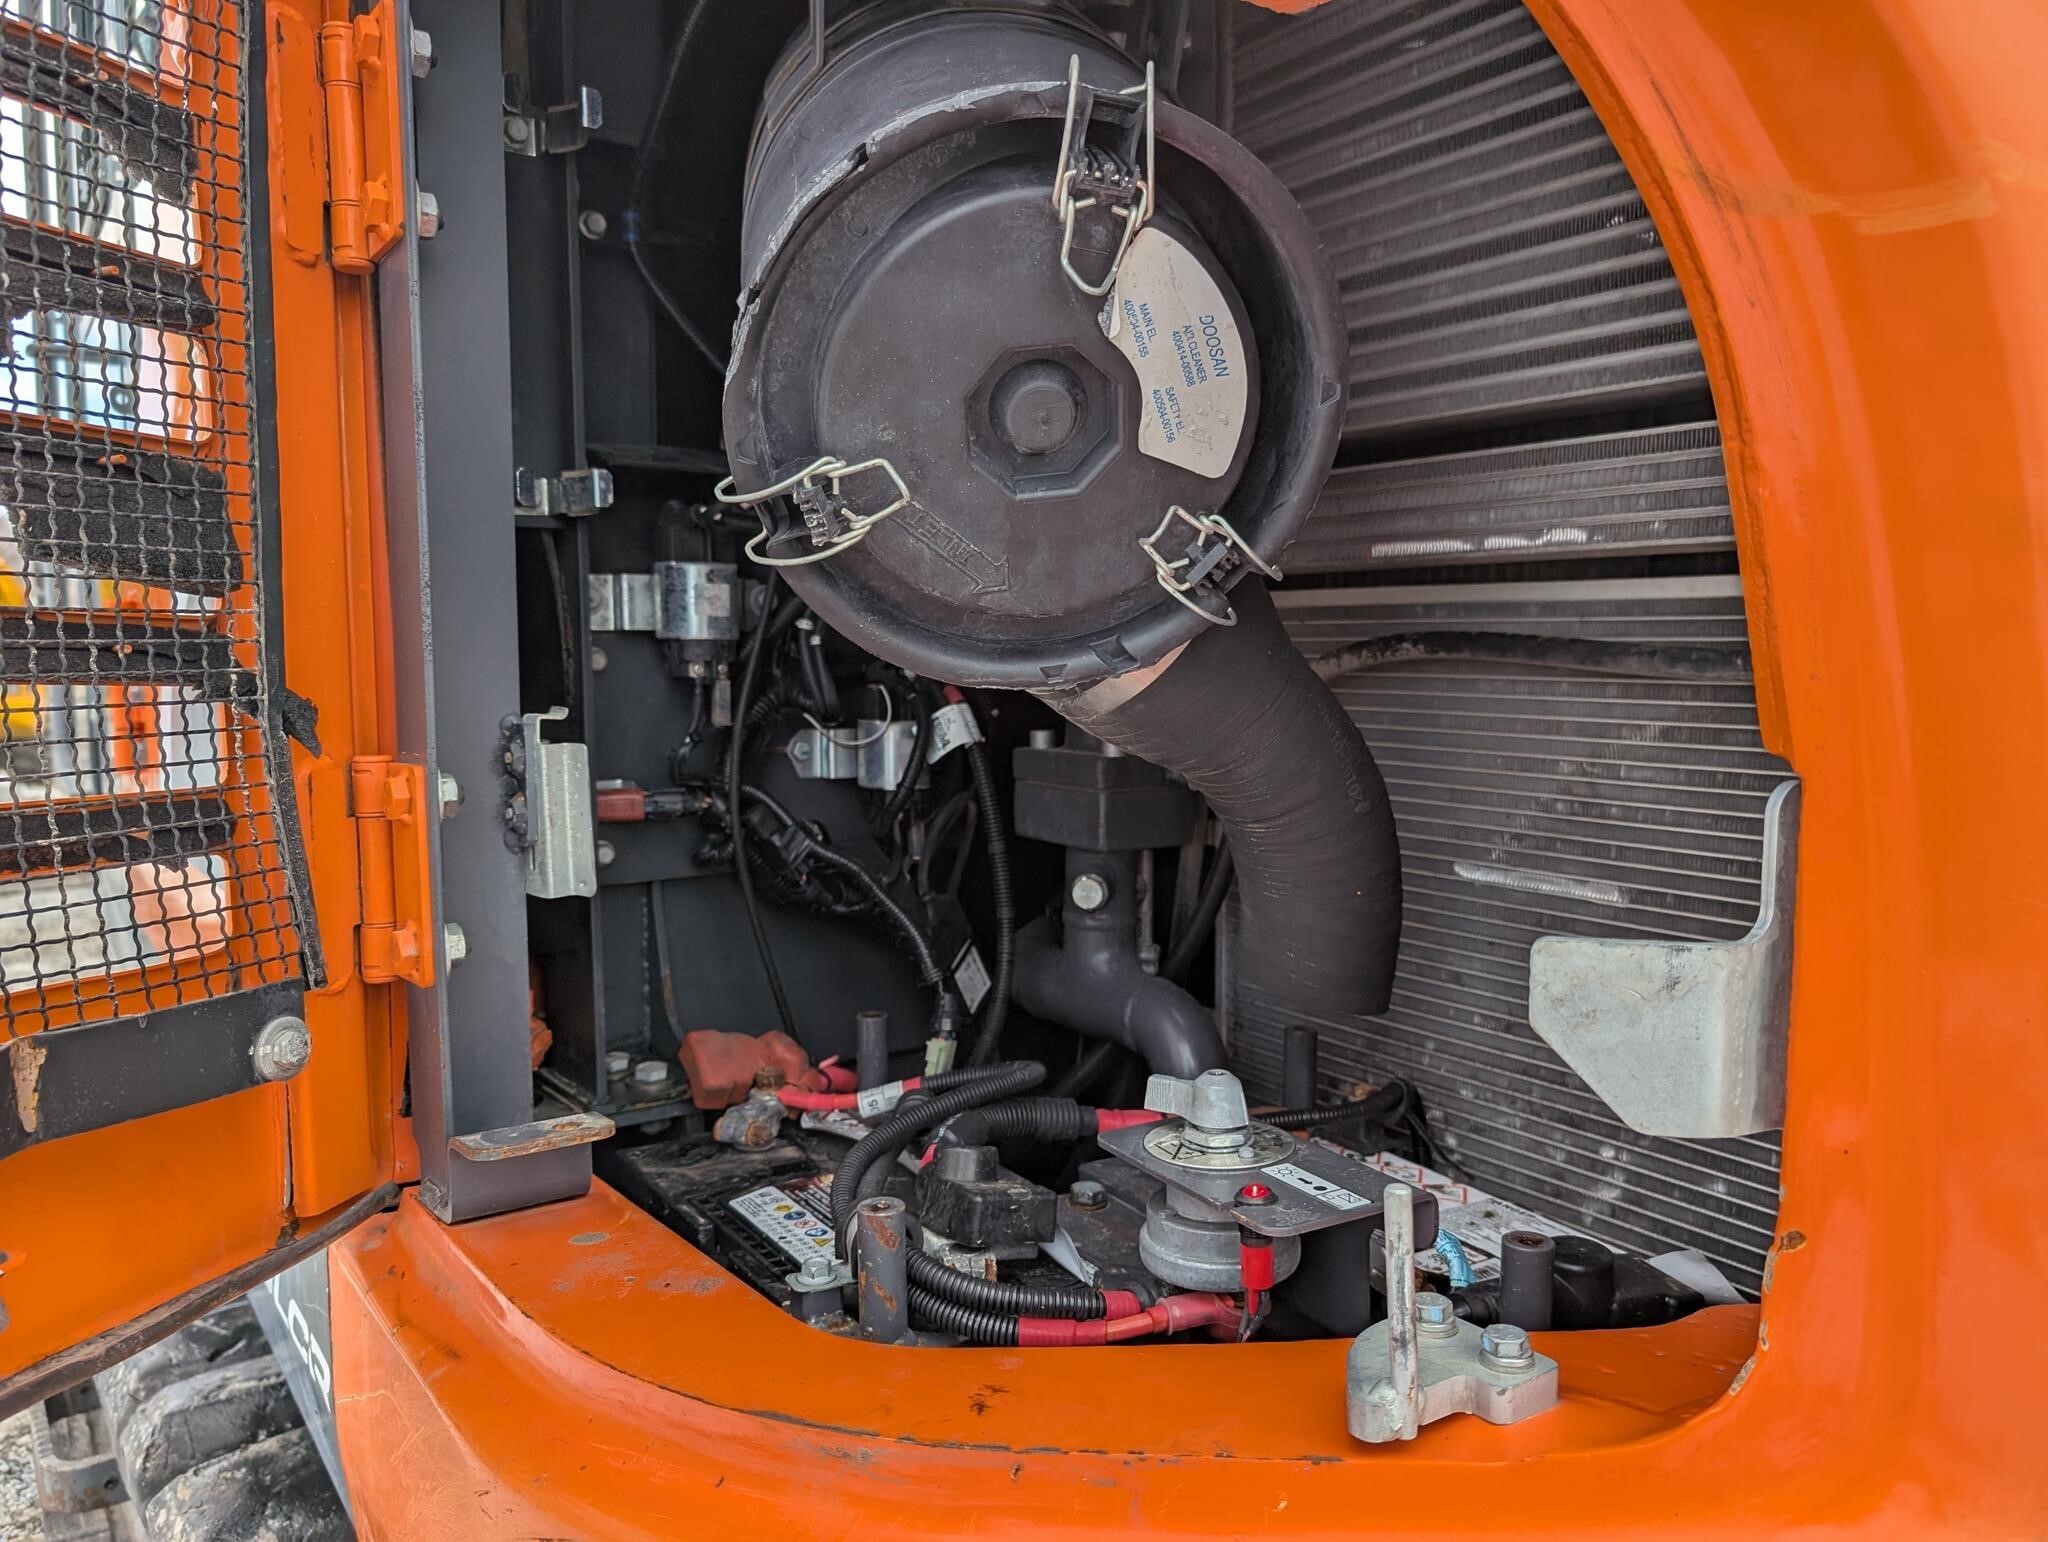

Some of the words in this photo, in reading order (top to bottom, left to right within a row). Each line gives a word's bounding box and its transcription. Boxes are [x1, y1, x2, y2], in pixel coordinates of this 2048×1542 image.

[1139, 303, 1154, 327] MAIN
[1183, 325, 1195, 341] AIR
[1172, 330, 1196, 387] 400414-00588
[1188, 342, 1207, 384] CLEANER
[1199, 315, 1230, 378] DOOSAN
[1153, 388, 1176, 443] 400504-00156
